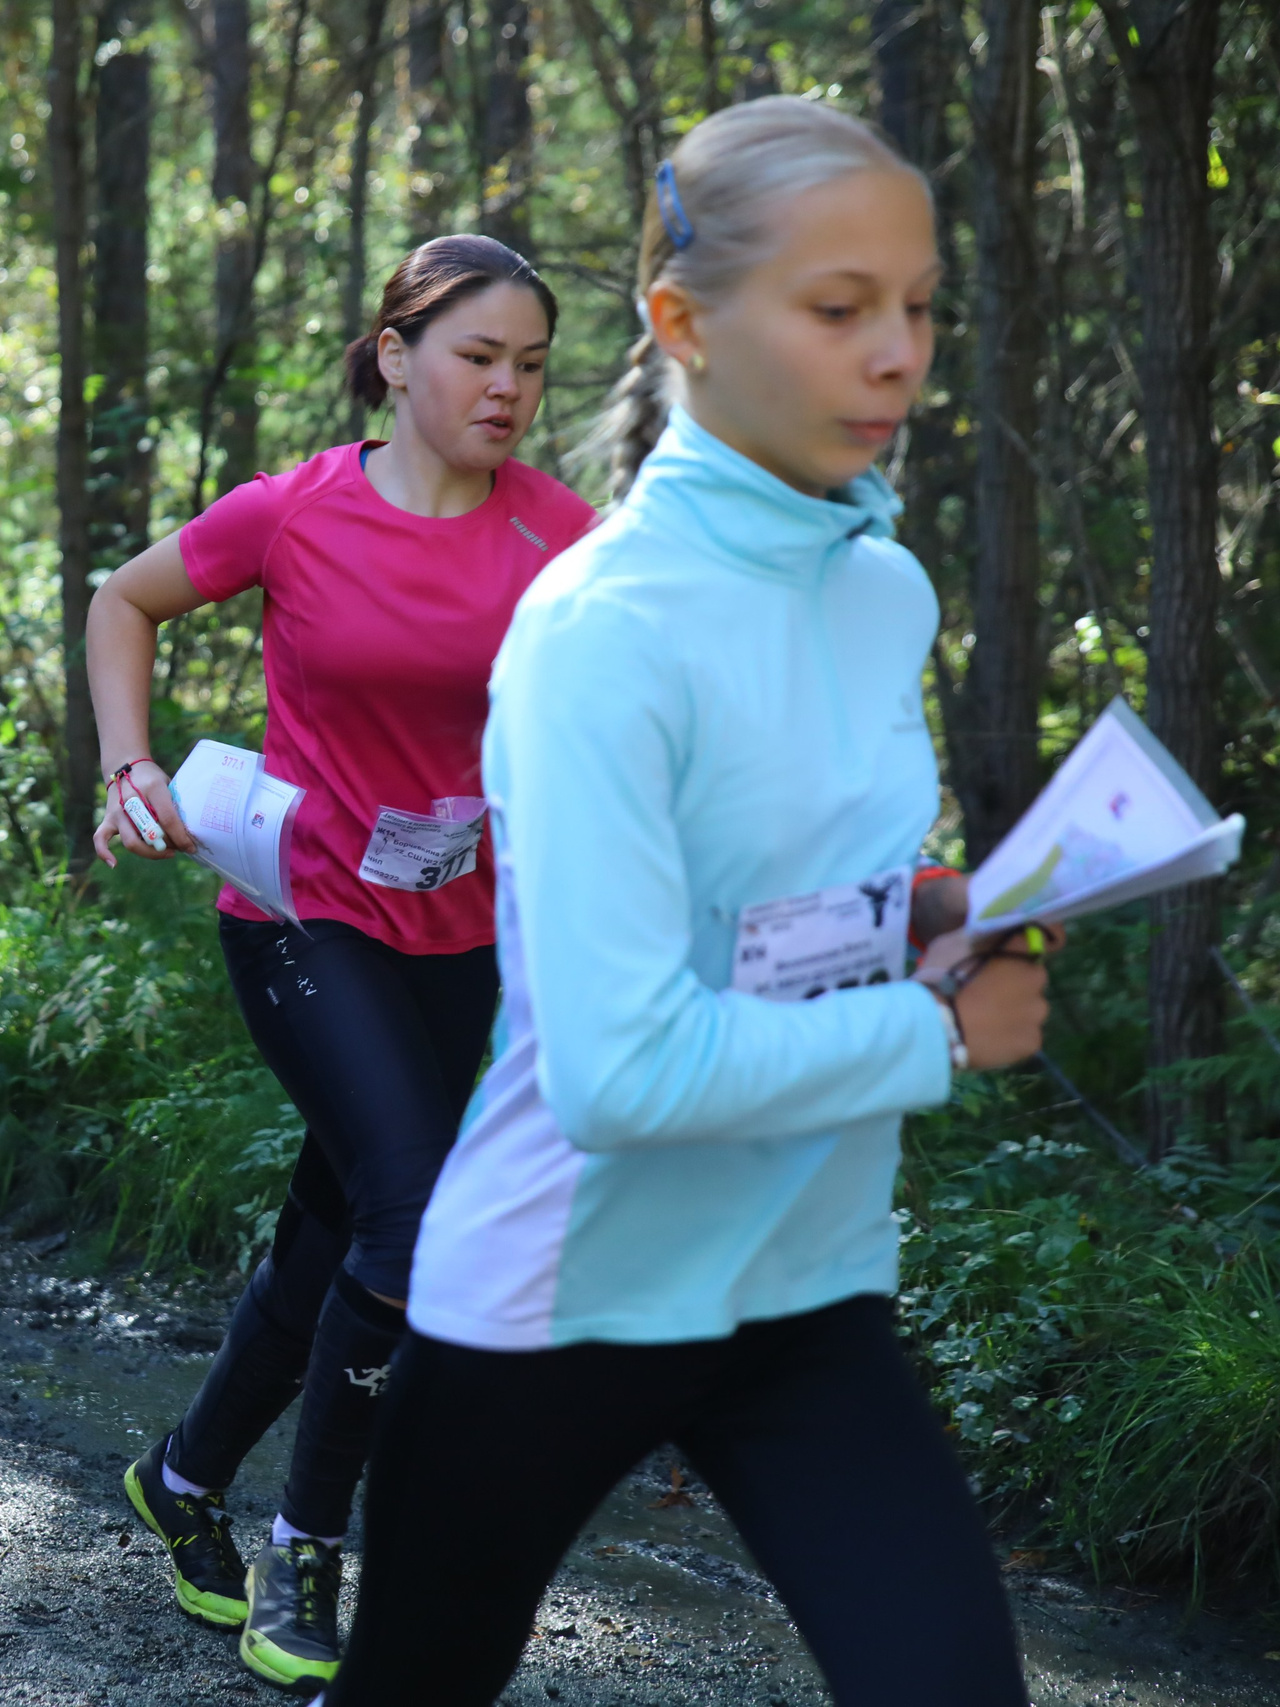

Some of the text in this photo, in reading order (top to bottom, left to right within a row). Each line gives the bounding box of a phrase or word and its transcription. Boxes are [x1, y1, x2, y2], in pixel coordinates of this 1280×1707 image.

[221, 755, 245, 771] 377.1
[375, 826, 396, 838] Ж14
[367, 855, 384, 865] чип
